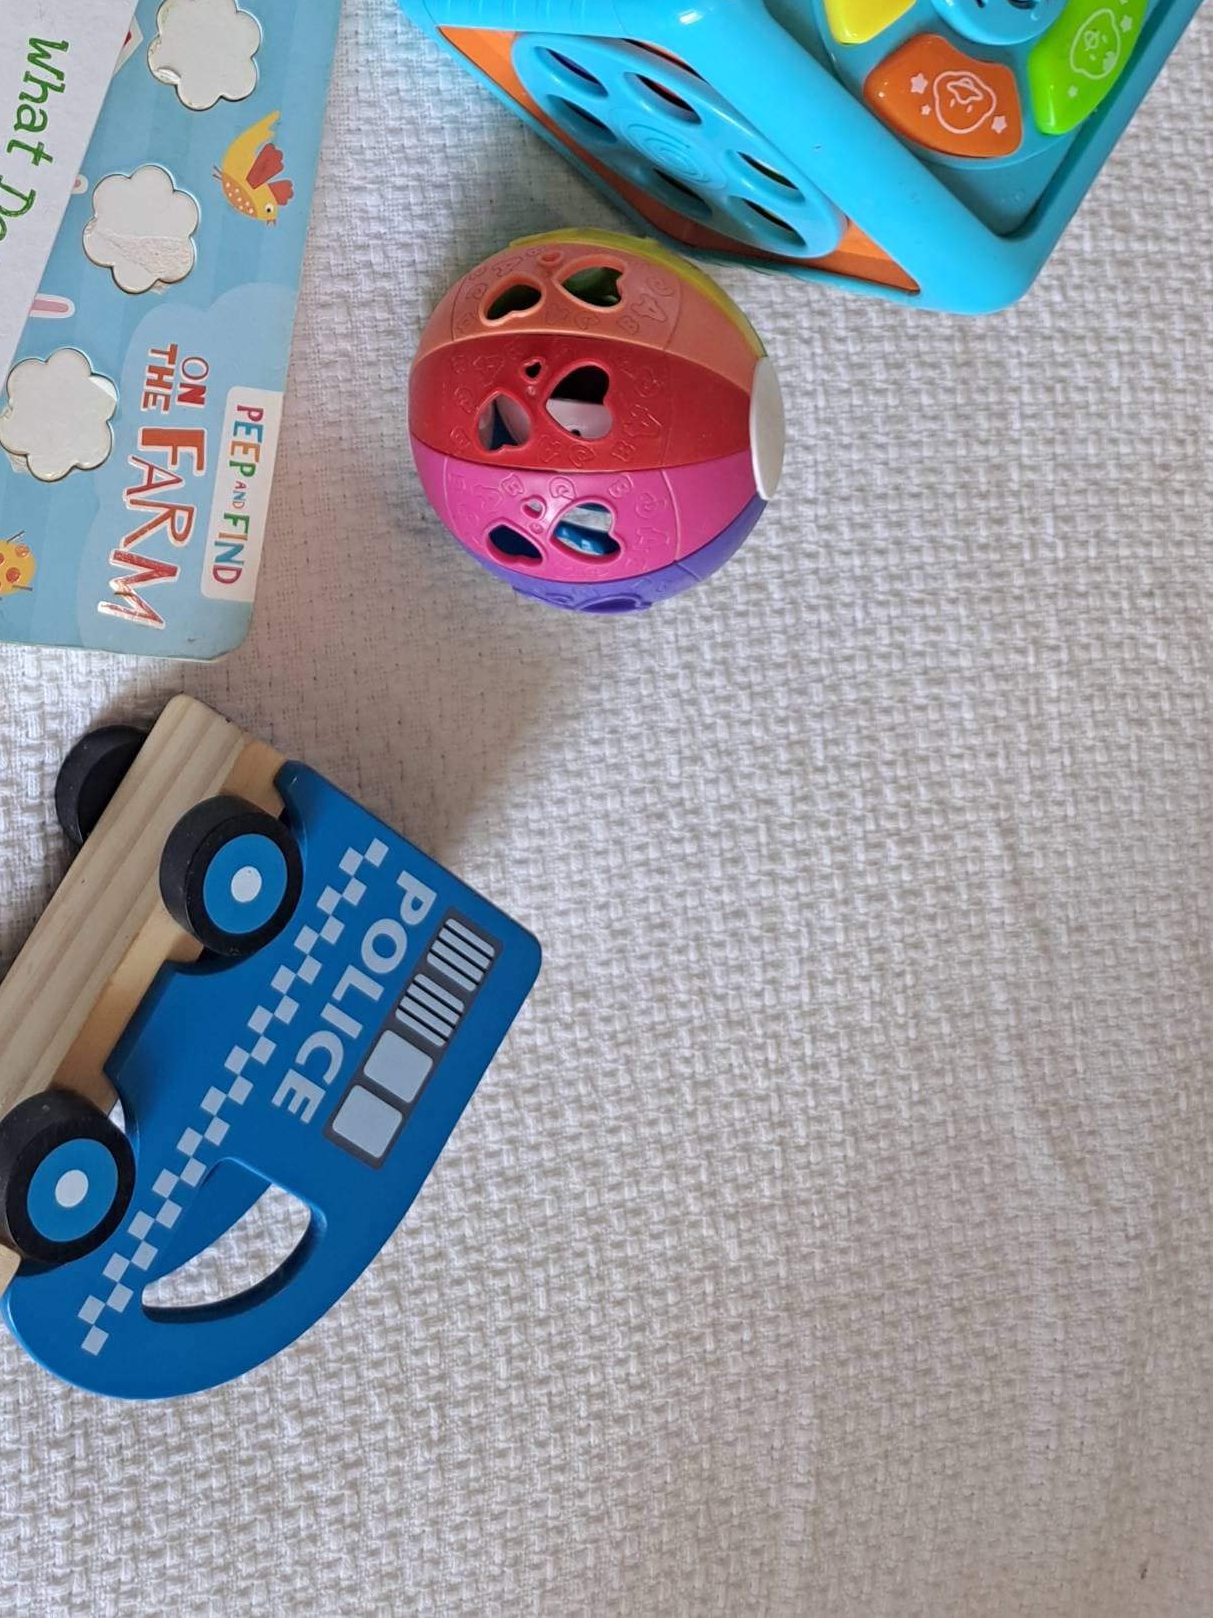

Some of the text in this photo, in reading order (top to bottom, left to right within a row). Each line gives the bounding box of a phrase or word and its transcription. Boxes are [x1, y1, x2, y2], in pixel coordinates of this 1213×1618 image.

[5, 36, 69, 166] What
[141, 342, 179, 413] THE
[177, 356, 210, 405] ON
[98, 427, 206, 628] FARM
[212, 404, 264, 584] PEEP AND FIND
[271, 869, 438, 1123] POLICE
